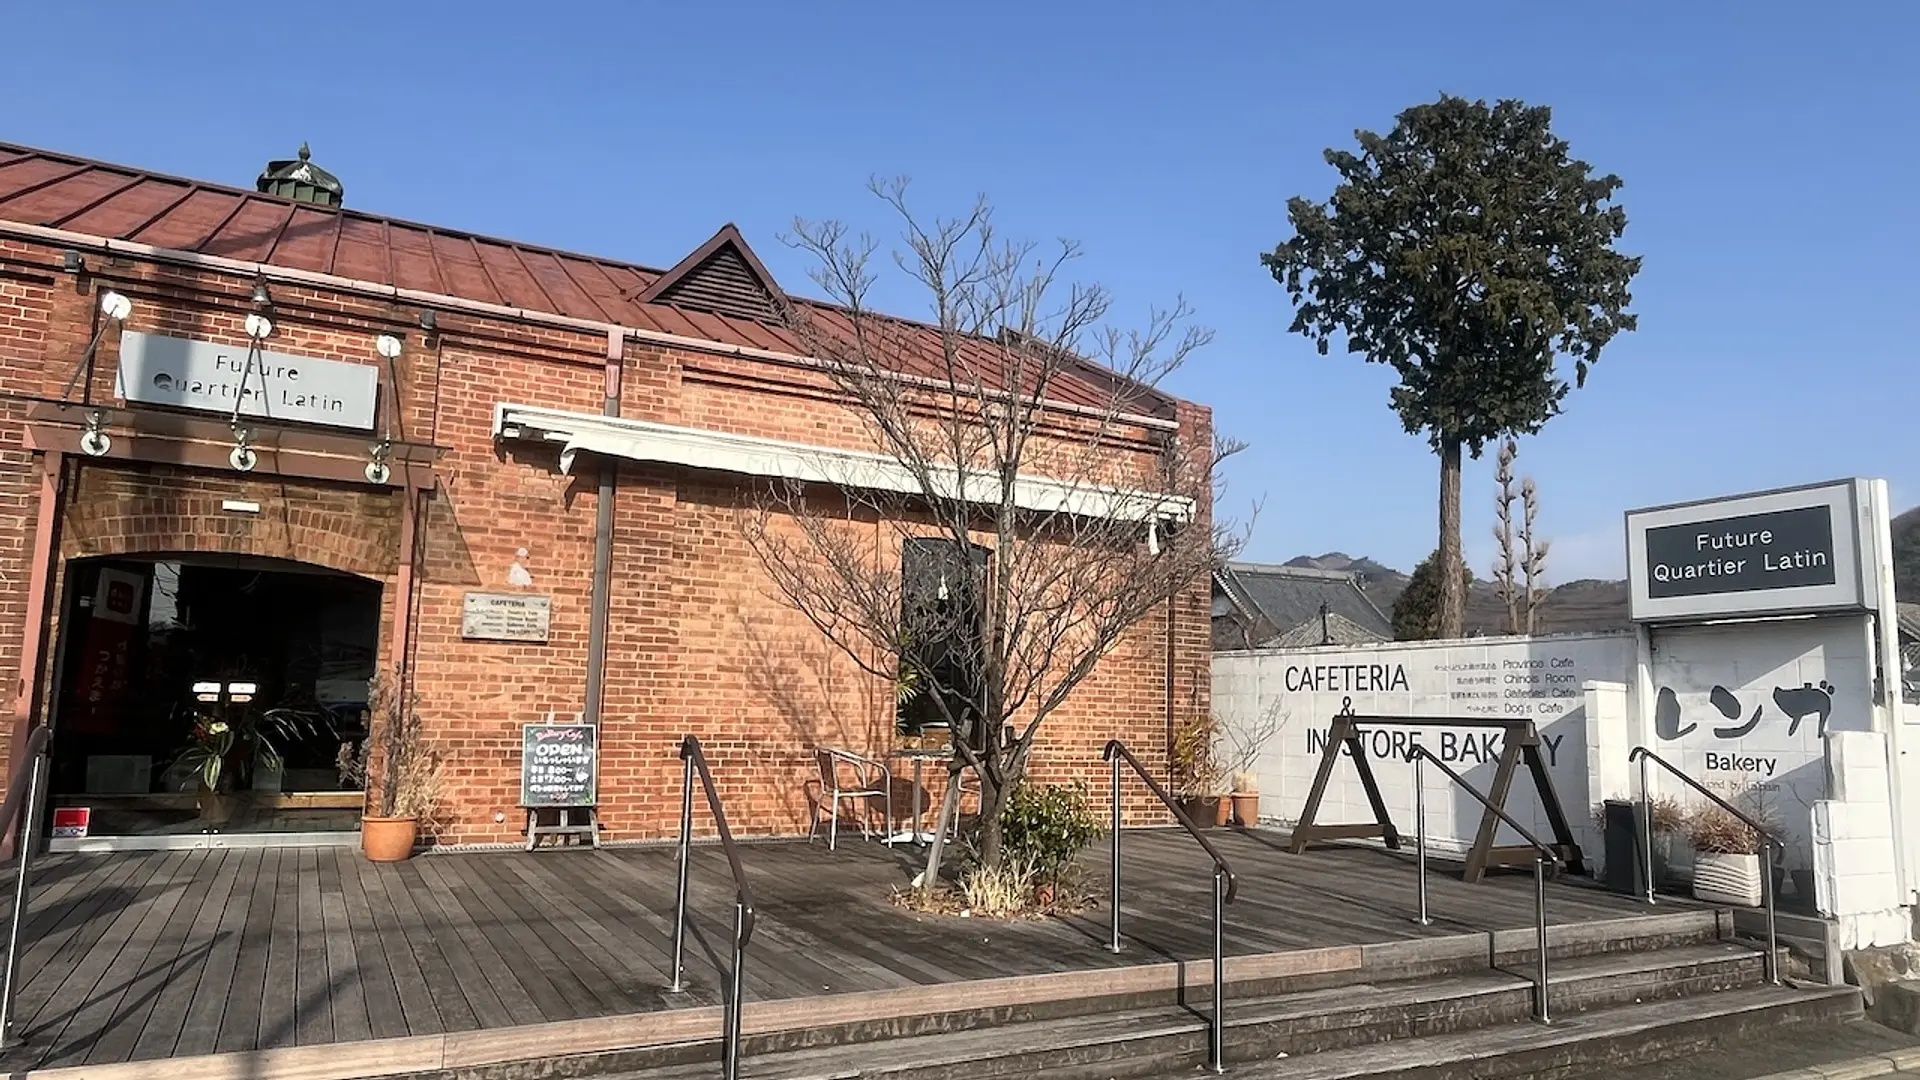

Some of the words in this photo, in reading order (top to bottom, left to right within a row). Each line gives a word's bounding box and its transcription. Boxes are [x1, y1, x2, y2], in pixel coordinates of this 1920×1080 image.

[215, 355, 299, 381] Future
[153, 373, 265, 402] Quartier
[282, 390, 344, 412] Latin
[1696, 530, 1773, 551] Future
[1654, 558, 1747, 582] Quartier
[1763, 550, 1826, 571] Latin
[491, 599, 525, 607] CAFETERIA
[1502, 659, 1545, 669] Province
[1551, 657, 1575, 669] Cafe
[1285, 664, 1409, 692] CAFETERIA
[1503, 674, 1540, 684] Chinois
[1545, 673, 1576, 684] Room
[1552, 687, 1576, 699] Cafe
[1341, 696, 1355, 717] &
[1538, 702, 1564, 714] Cafe
[1655, 680, 1835, 741] レンガ
[535, 743, 583, 757] OPEN
[1307, 728, 1327, 755] IN
[1341, 730, 1422, 759] TORE
[1440, 732, 1564, 766] BAKY
[1705, 752, 1777, 777] Bakery
